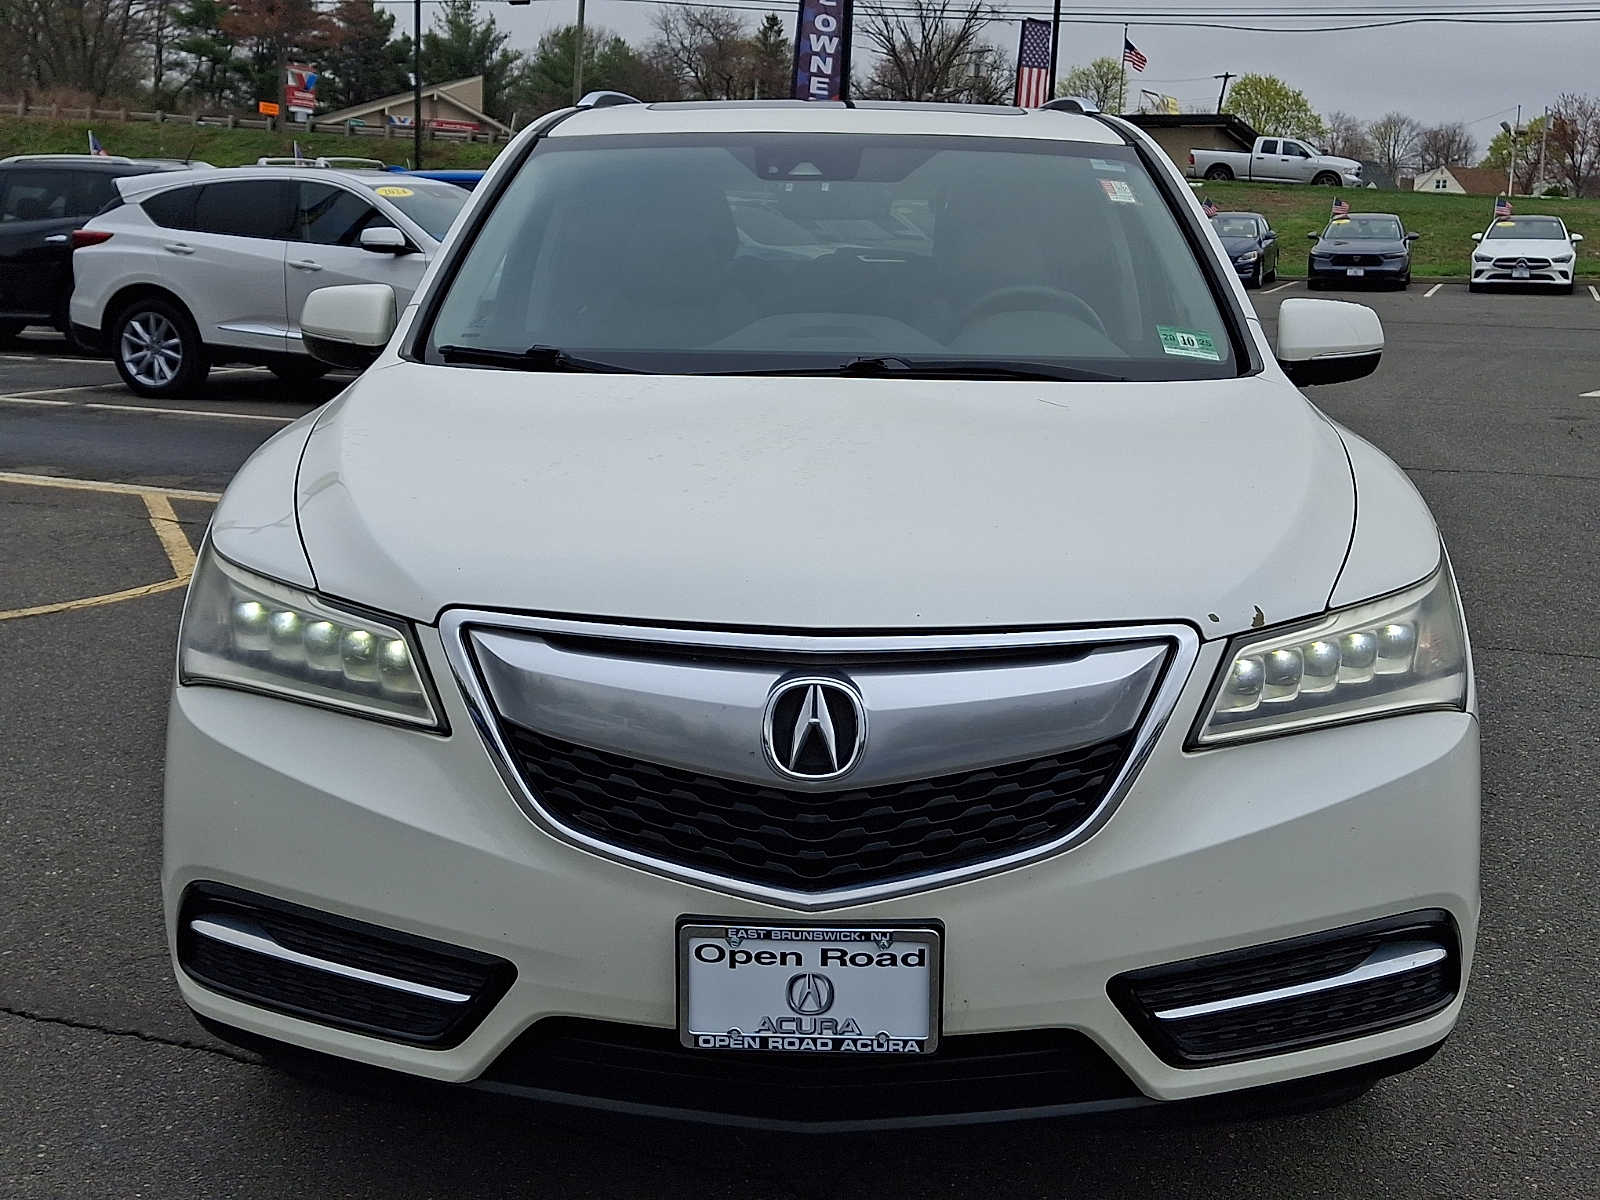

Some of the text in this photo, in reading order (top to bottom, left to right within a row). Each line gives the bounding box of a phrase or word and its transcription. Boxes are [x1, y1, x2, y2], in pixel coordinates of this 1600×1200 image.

[809, 0, 839, 100] OWNE
[1180, 335, 1195, 346] 10
[728, 929, 766, 940] EAST
[871, 932, 890, 942] NJ
[694, 943, 926, 969] Open Road
[755, 1015, 862, 1035] ACURA
[699, 1035, 921, 1052] OPEN ROAD ACURA
